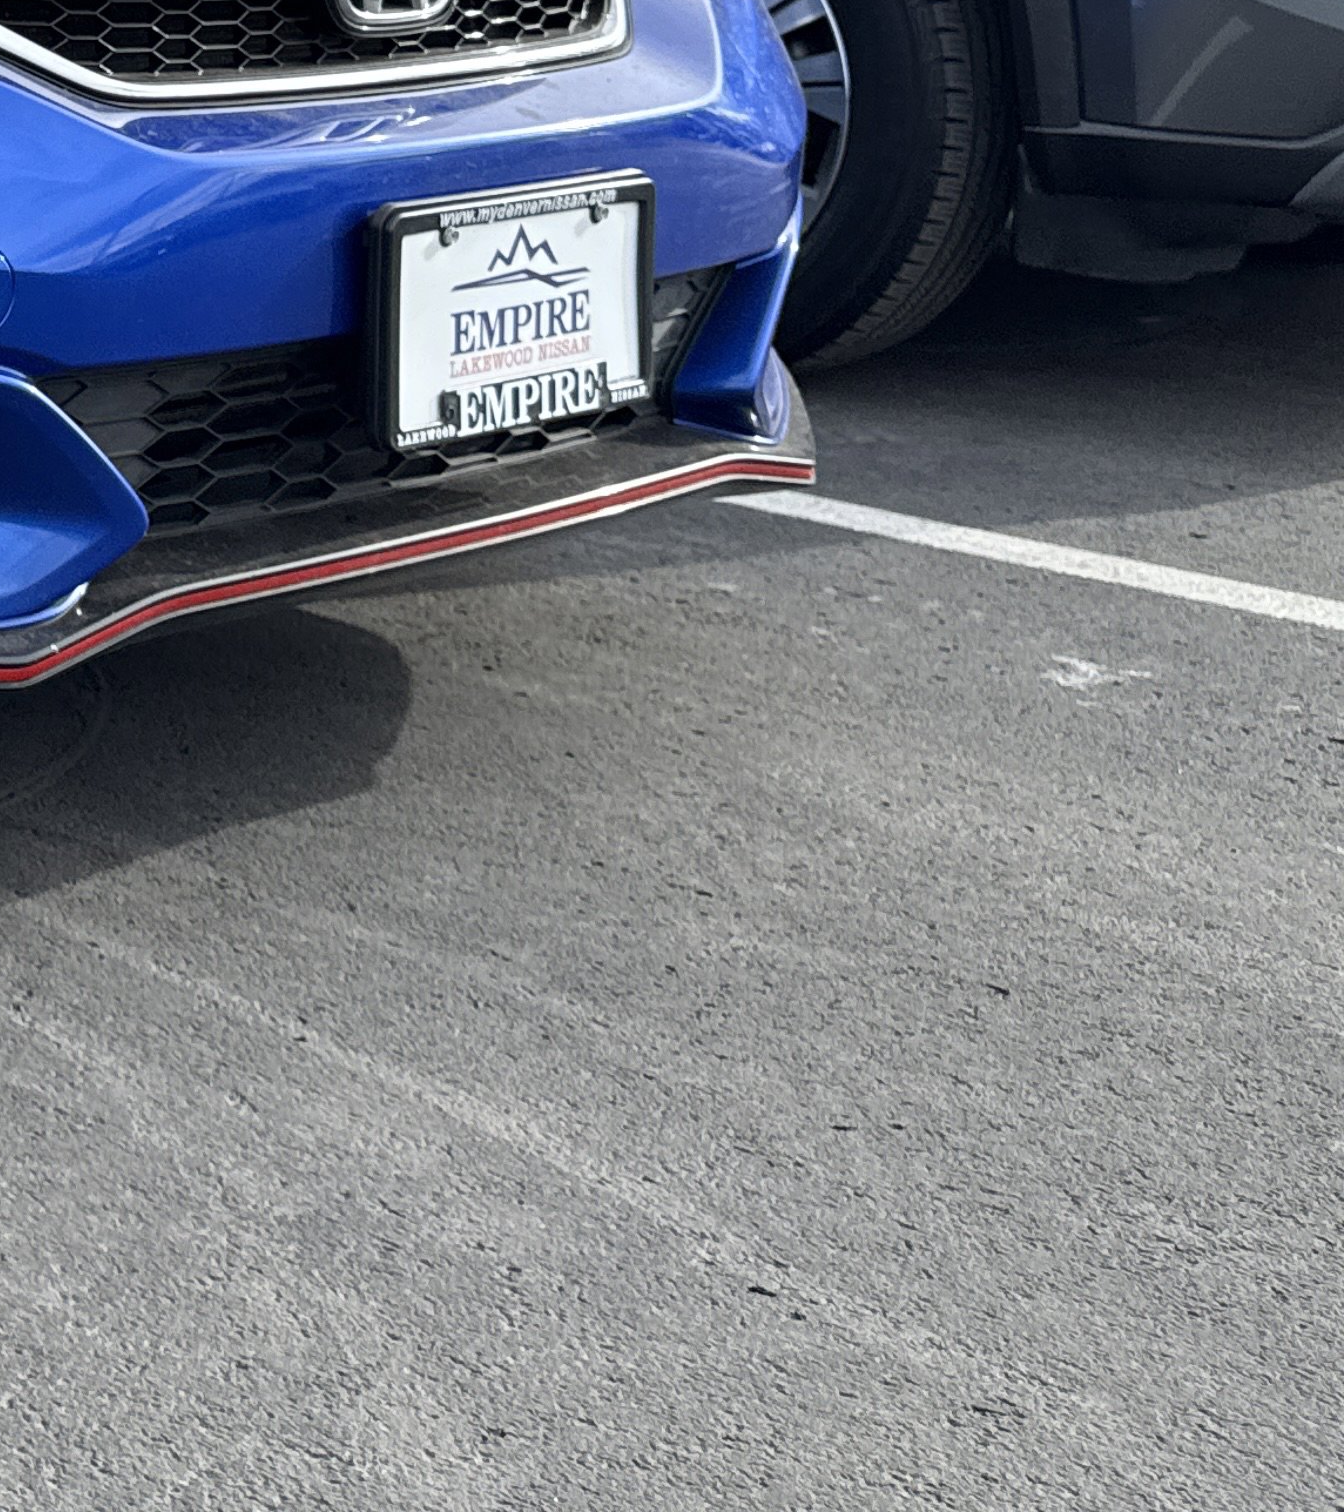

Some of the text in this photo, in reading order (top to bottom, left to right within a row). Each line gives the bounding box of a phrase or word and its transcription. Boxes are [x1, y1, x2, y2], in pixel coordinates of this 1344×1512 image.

[440, 189, 616, 228] www.mydenvernissan.com
[450, 289, 590, 356] EMPIRE
[449, 334, 591, 378] LAKEWOOD NISSAN
[457, 366, 600, 437] EMPIRE
[397, 423, 457, 447] LAKEWOOD
